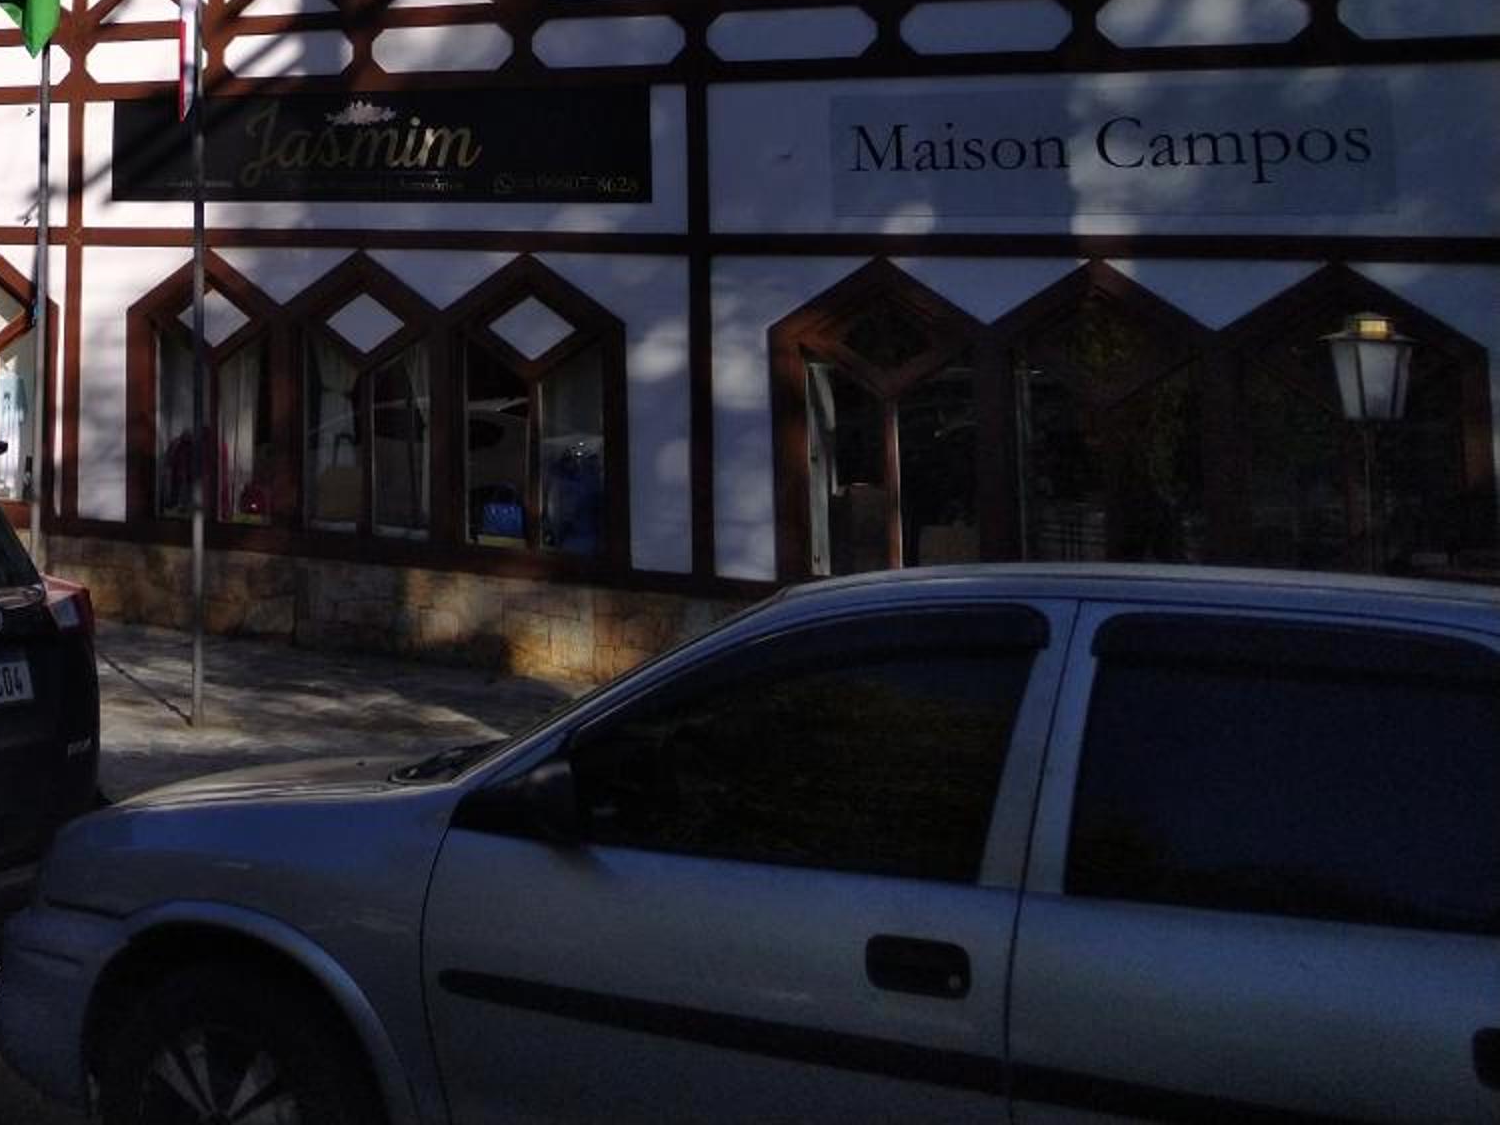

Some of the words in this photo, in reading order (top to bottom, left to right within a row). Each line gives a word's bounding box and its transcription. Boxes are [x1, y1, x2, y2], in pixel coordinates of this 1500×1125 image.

[242, 101, 483, 187] Jasmim
[850, 122, 1071, 172] Maison
[1096, 116, 1373, 185] Campos
